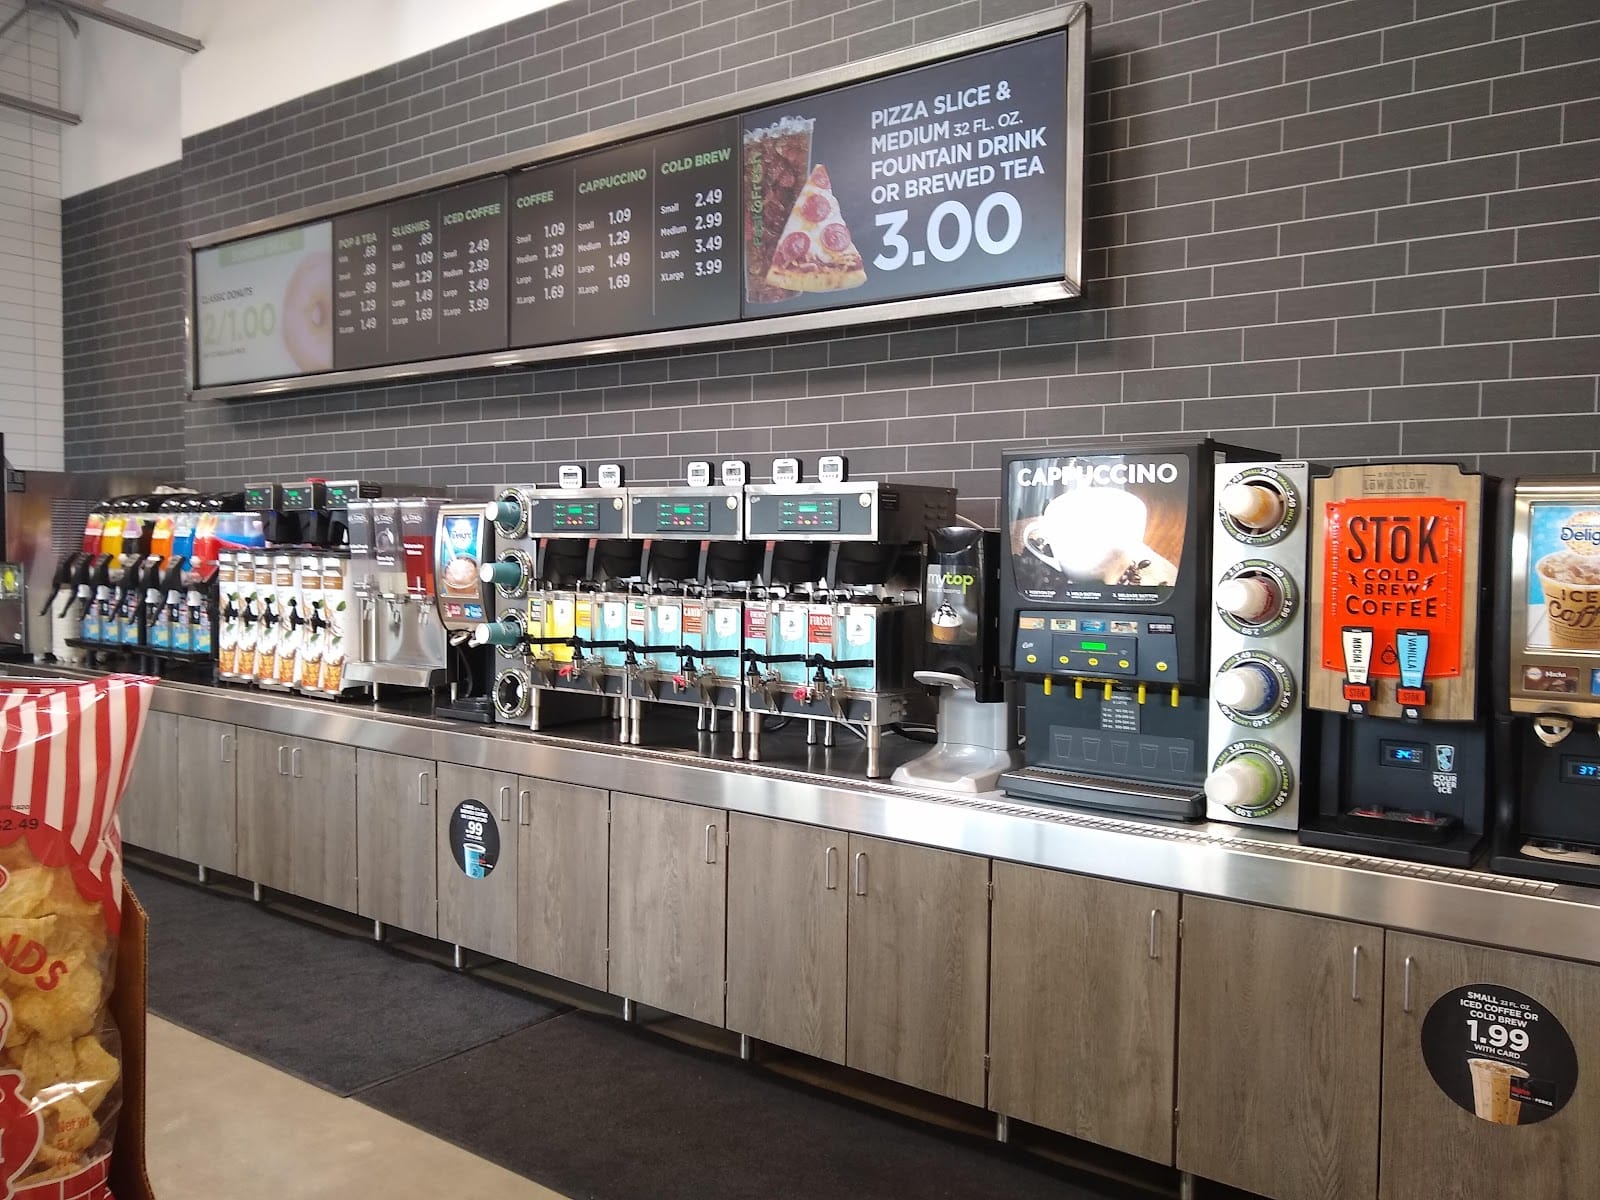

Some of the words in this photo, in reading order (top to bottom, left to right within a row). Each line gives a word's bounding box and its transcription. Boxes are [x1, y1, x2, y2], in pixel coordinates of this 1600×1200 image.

[872, 100, 928, 129] PIZZA
[934, 84, 990, 114] SLICE
[996, 80, 1012, 100] &
[871, 121, 950, 154] MEDIUM
[954, 122, 970, 137] 32
[972, 116, 994, 133] FL.
[998, 110, 1024, 127] OZ.
[660, 158, 692, 175] COLD
[695, 148, 732, 165] BREW
[871, 142, 972, 180] FOUNTAIN
[978, 126, 1048, 159] DRINK
[578, 169, 648, 194] CAPPUCCINO
[871, 181, 899, 205] OR
[905, 165, 995, 199] BREWED
[1000, 155, 1045, 180] TEA
[516, 190, 554, 209] COFFEE
[660, 203, 679, 215] Small
[695, 188, 723, 208] 2.49
[443, 212, 464, 226] ICED
[465, 203, 501, 220] COFFEE
[578, 221, 595, 232] Small
[608, 208, 632, 225] 1.09
[660, 225, 688, 237] Medium
[695, 212, 723, 231] 2.99
[516, 234, 532, 244] Small
[544, 222, 565, 238] 1.09
[578, 242, 601, 254] Medium
[608, 230, 631, 246] 1.29
[872, 191, 1023, 271] 3.00
[468, 238, 490, 254] 2.49
[516, 253, 538, 264] Medium
[544, 243, 565, 259] 1.29
[660, 249, 680, 260] Large
[695, 235, 723, 254] 3.49
[468, 258, 490, 274] 2.99
[578, 264, 595, 275] Large
[608, 252, 631, 268] 1.49
[660, 271, 685, 283] XLarge
[695, 259, 723, 277] 3.99
[415, 270, 432, 284] 1.29
[468, 278, 490, 292] 3.49
[516, 275, 532, 286] Large
[544, 264, 565, 280] 1.49
[578, 284, 599, 295] XLarge
[608, 274, 631, 290] 1.69
[415, 289, 433, 303] 1.49
[544, 285, 565, 300] 1.69
[468, 298, 490, 312] 3.99
[360, 317, 376, 330] 1.49
[1016, 463, 1178, 486] CAPPUCCINO
[928, 572, 974, 594] mytop
[1364, 569, 1419, 581] COLD
[1364, 584, 1420, 595] BREW
[1346, 595, 1437, 617] COFFEE
[1352, 638, 1362, 663] MOCHA
[1407, 638, 1417, 668] VANILLA
[1269, 658, 1285, 673] 3.49
[1269, 750, 1284, 766] 3.99
[1433, 774, 1457, 782] POUR
[1433, 780, 1457, 788] OVER
[1467, 991, 1499, 1004] SMALL
[1460, 999, 1482, 1009] ICED
[1484, 1003, 1522, 1018] COFFEE
[1524, 1012, 1539, 1022] OR
[1470, 1009, 1496, 1022] COLD
[1498, 1016, 1528, 1028] BREW
[1466, 1020, 1530, 1052] 1.99
[1474, 1044, 1496, 1054] WITH
[1497, 1048, 1520, 1059] CARD
